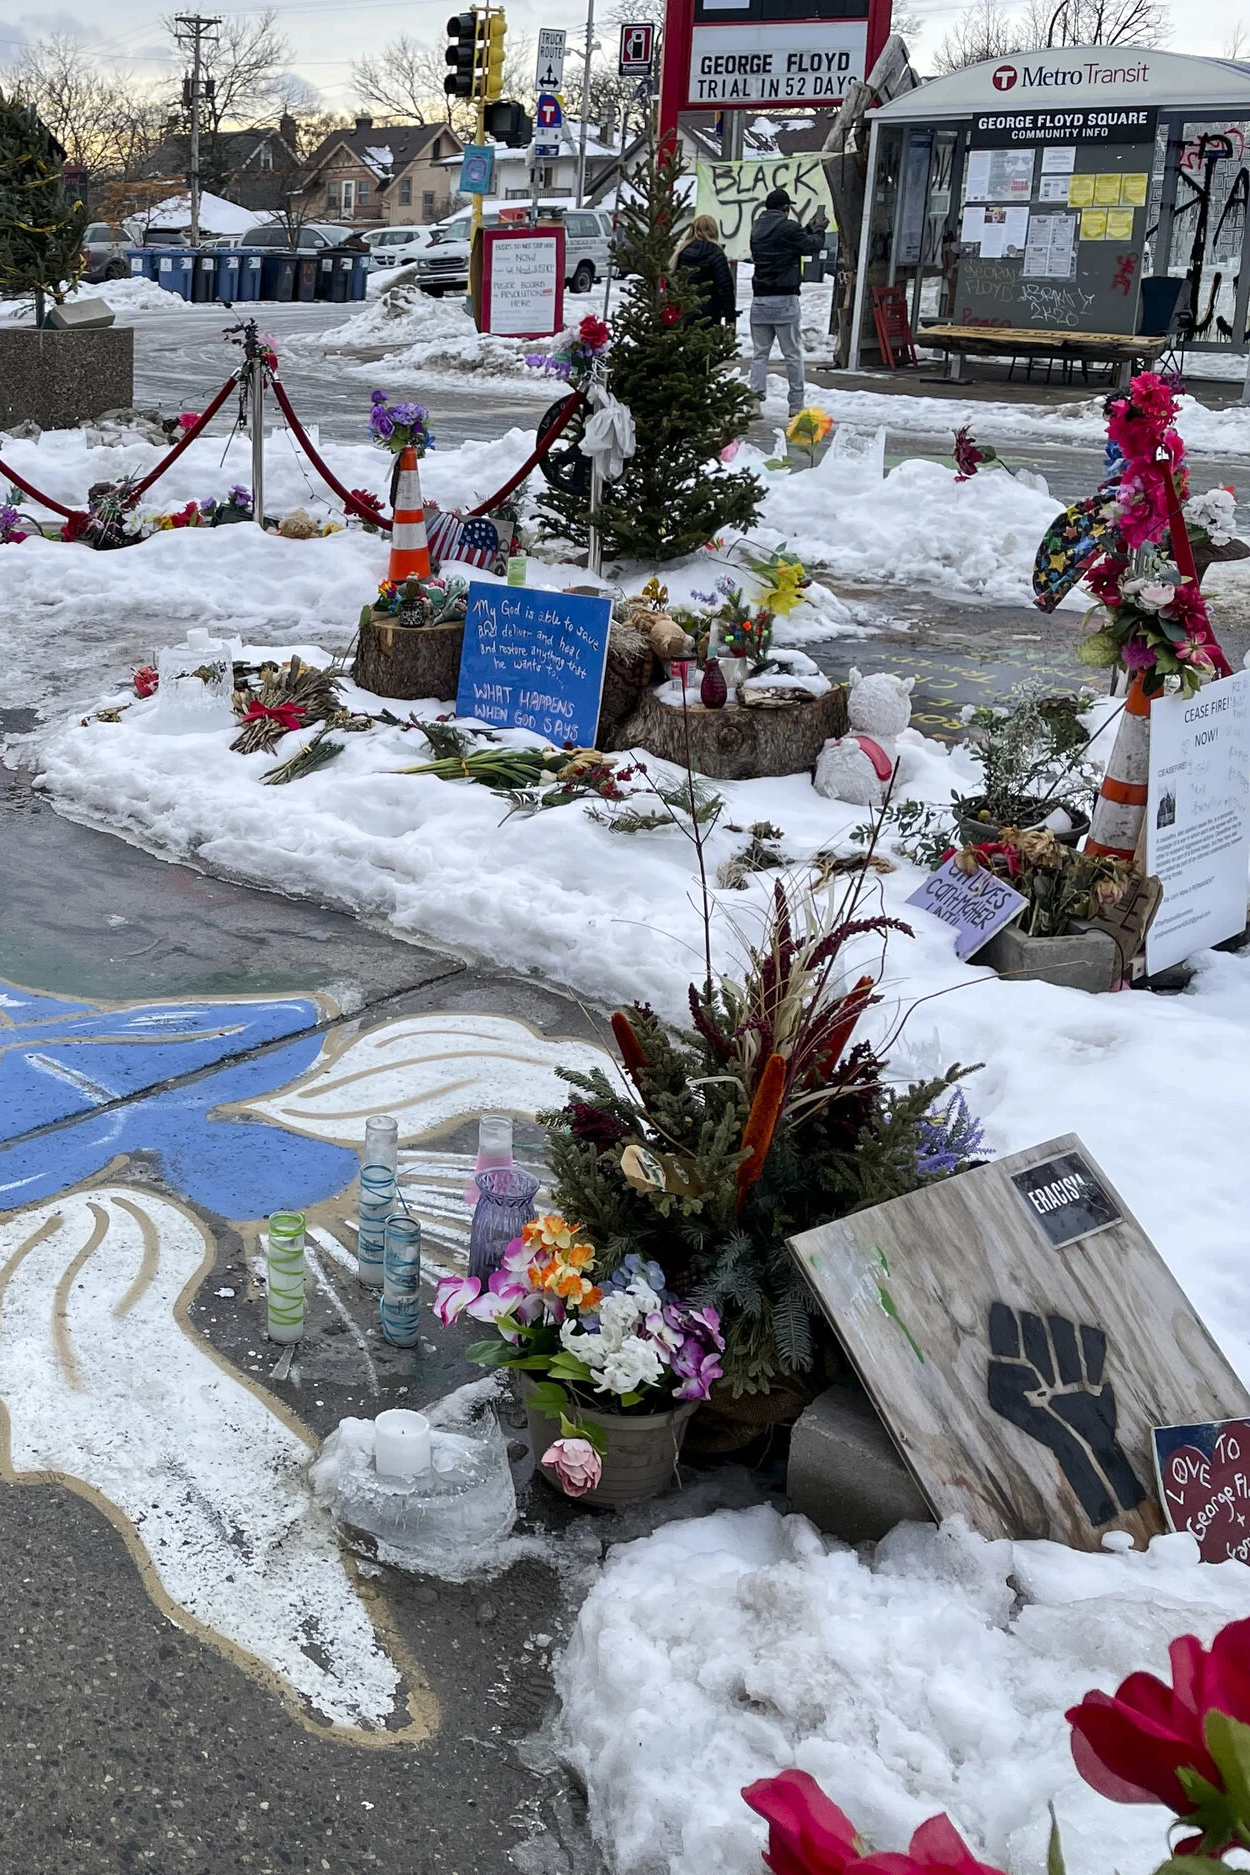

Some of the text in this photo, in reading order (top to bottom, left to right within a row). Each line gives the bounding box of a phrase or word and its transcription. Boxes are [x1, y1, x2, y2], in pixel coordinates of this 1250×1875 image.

[542, 32, 564, 45] TRUCK
[541, 46, 563, 59] ROUTE
[701, 52, 850, 75] GEORGE FLOYD
[698, 79, 750, 98] TRIAL
[760, 79, 779, 98] IN
[785, 77, 806, 96] 52
[1021, 66, 1083, 88] Metro
[1084, 62, 1150, 84] Transit
[978, 112, 1148, 130] GEORGE FLOYD SQUARE
[1011, 127, 1109, 140] COMMUNITY INFO
[710, 160, 820, 196] BLACK
[516, 253, 536, 261] NOW
[472, 599, 600, 651] My God is able to save
[502, 624, 533, 637] deliver
[536, 631, 553, 646] and
[559, 636, 581, 661] heal
[480, 641, 587, 680] and restore anything that
[493, 657, 507, 670] he
[513, 659, 541, 673] wants
[473, 683, 576, 718] WHAT HAPPENS
[1184, 697, 1230, 723] CEASE FIRE!
[474, 703, 579, 742] WHEN GOD SAYS
[1194, 727, 1219, 747] NOW!
[1166, 1433, 1240, 1505] LOVE TO
[1186, 1486, 1235, 1542] George
